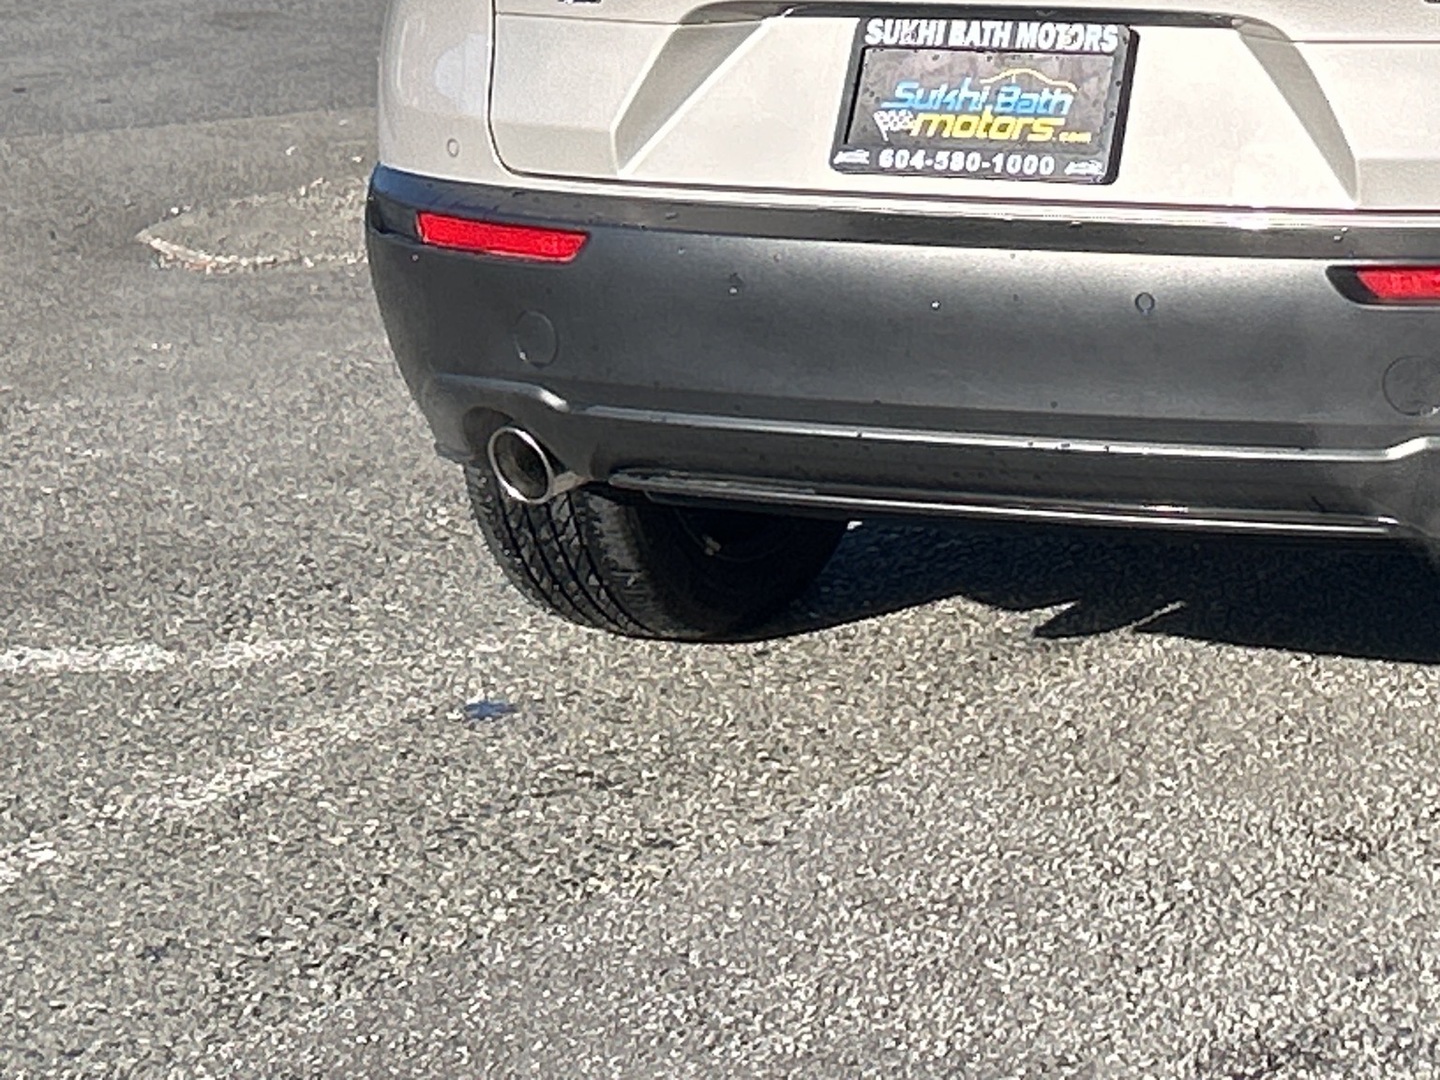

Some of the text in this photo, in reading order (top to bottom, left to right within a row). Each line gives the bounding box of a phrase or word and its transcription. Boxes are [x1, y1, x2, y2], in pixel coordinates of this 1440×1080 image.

[865, 17, 1119, 52] SUKHI BATH MOTORS
[881, 75, 1074, 116] Sukhi Bath
[878, 149, 1055, 176] 604-580-1000
